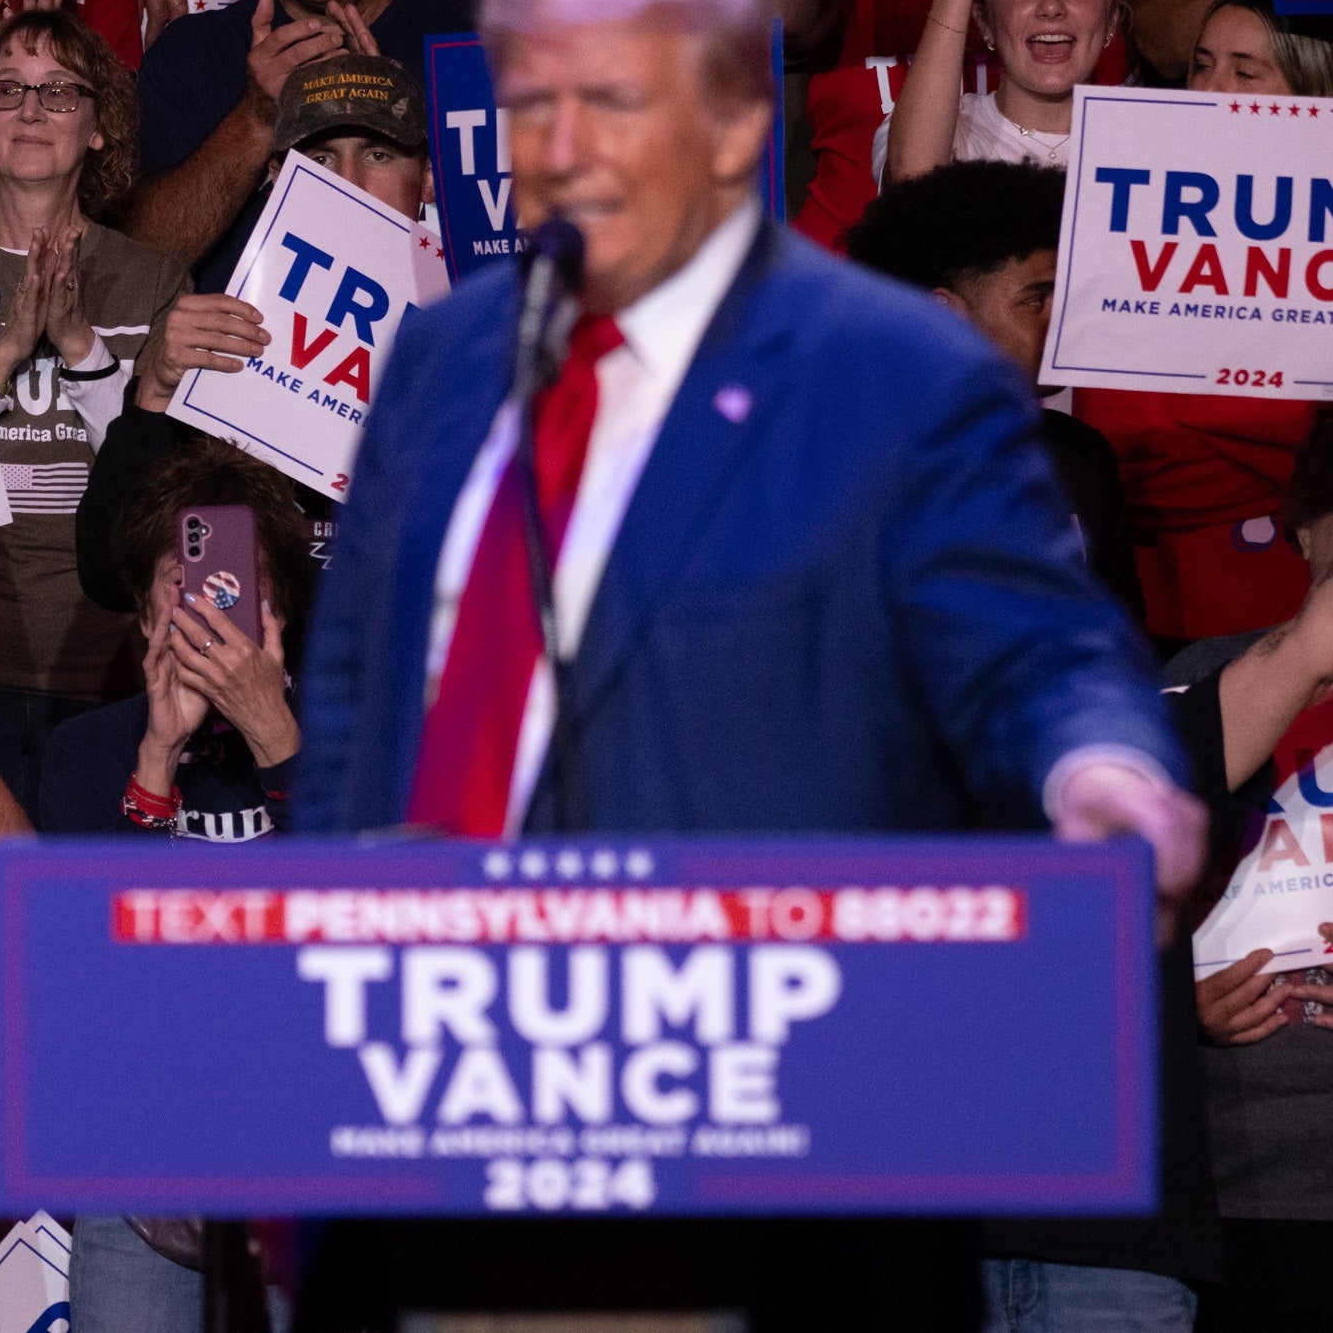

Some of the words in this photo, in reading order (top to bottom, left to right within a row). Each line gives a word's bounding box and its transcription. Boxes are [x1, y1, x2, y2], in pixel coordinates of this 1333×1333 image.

[303, 78, 338, 91] MAKE
[339, 73, 394, 88] AMERICA
[306, 89, 346, 103] GREAT
[350, 86, 389, 101] AGAIN
[1102, 299, 1160, 315] MAKE
[1169, 303, 1262, 320] AMERICA
[1216, 368, 1283, 388] 2024
[122, 892, 275, 942] TEXT
[285, 889, 734, 940] PENNSYLVANIA
[746, 894, 821, 940] TO
[296, 945, 844, 1049] TRUMP
[360, 1044, 781, 1125] VANCE
[485, 1158, 657, 1211] 2024
